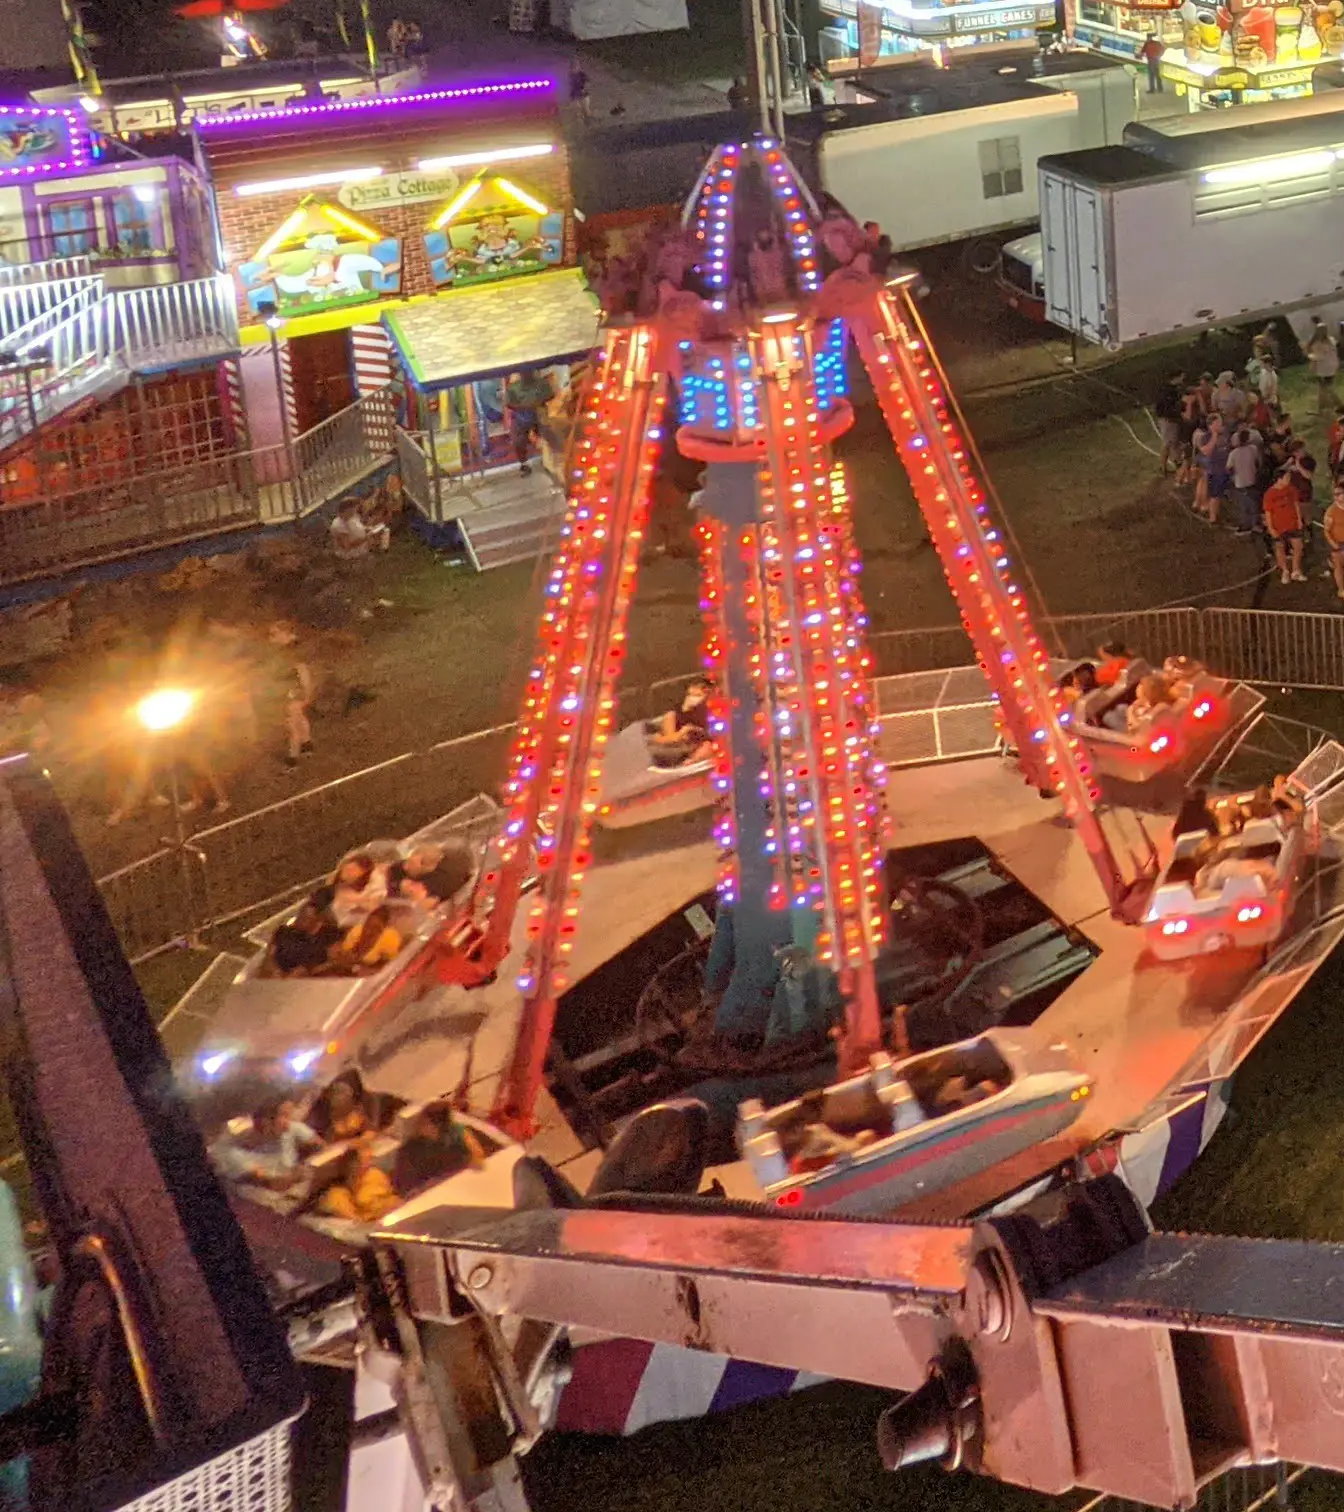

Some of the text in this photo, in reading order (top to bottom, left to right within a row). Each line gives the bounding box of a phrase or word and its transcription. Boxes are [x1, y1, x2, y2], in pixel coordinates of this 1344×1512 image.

[956, 13, 997, 29] FUNNEL
[1001, 9, 1034, 25] CAKES
[349, 185, 391, 206] Pizza
[397, 178, 452, 196] Cottage
